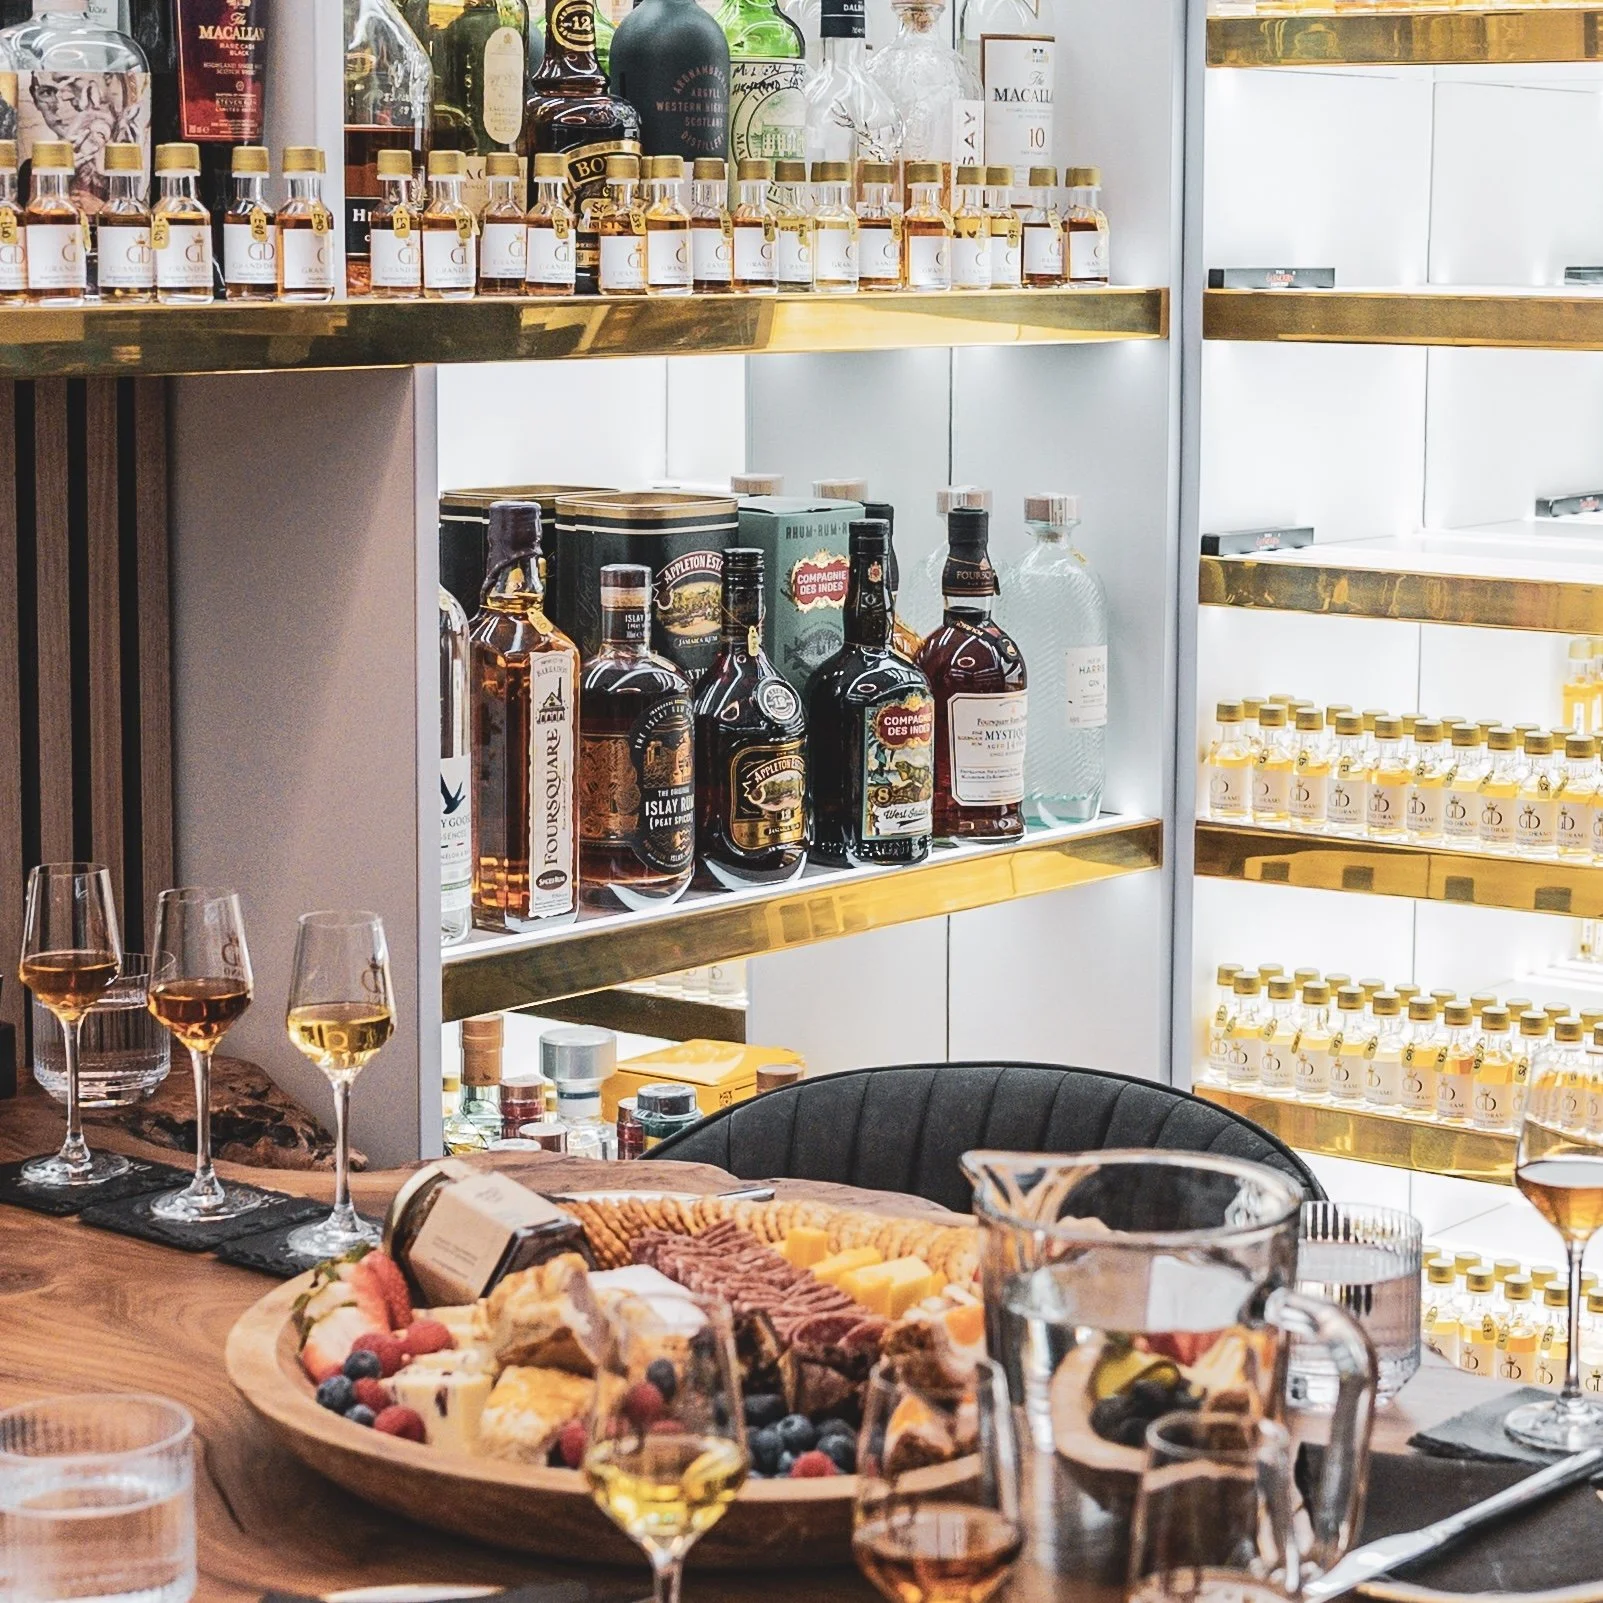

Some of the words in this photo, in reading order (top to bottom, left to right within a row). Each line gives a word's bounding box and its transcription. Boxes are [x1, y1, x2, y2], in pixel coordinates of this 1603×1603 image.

[199, 25, 265, 41] MACALLAN
[656, 101, 702, 112] WESTERN
[1030, 127, 1045, 148] 10
[664, 553, 707, 584] APPLETON
[797, 569, 848, 586] COMPAGNIE
[800, 583, 817, 596] DES
[818, 580, 845, 594] INDES
[887, 725, 908, 737] DES
[754, 758, 791, 783] APPLETON
[544, 728, 561, 866] FOURSQUARE
[645, 798, 678, 817] ISLAY
[1481, 809, 1503, 826] GD
[1519, 813, 1541, 829] GD
[1500, 1364, 1522, 1380] GD
